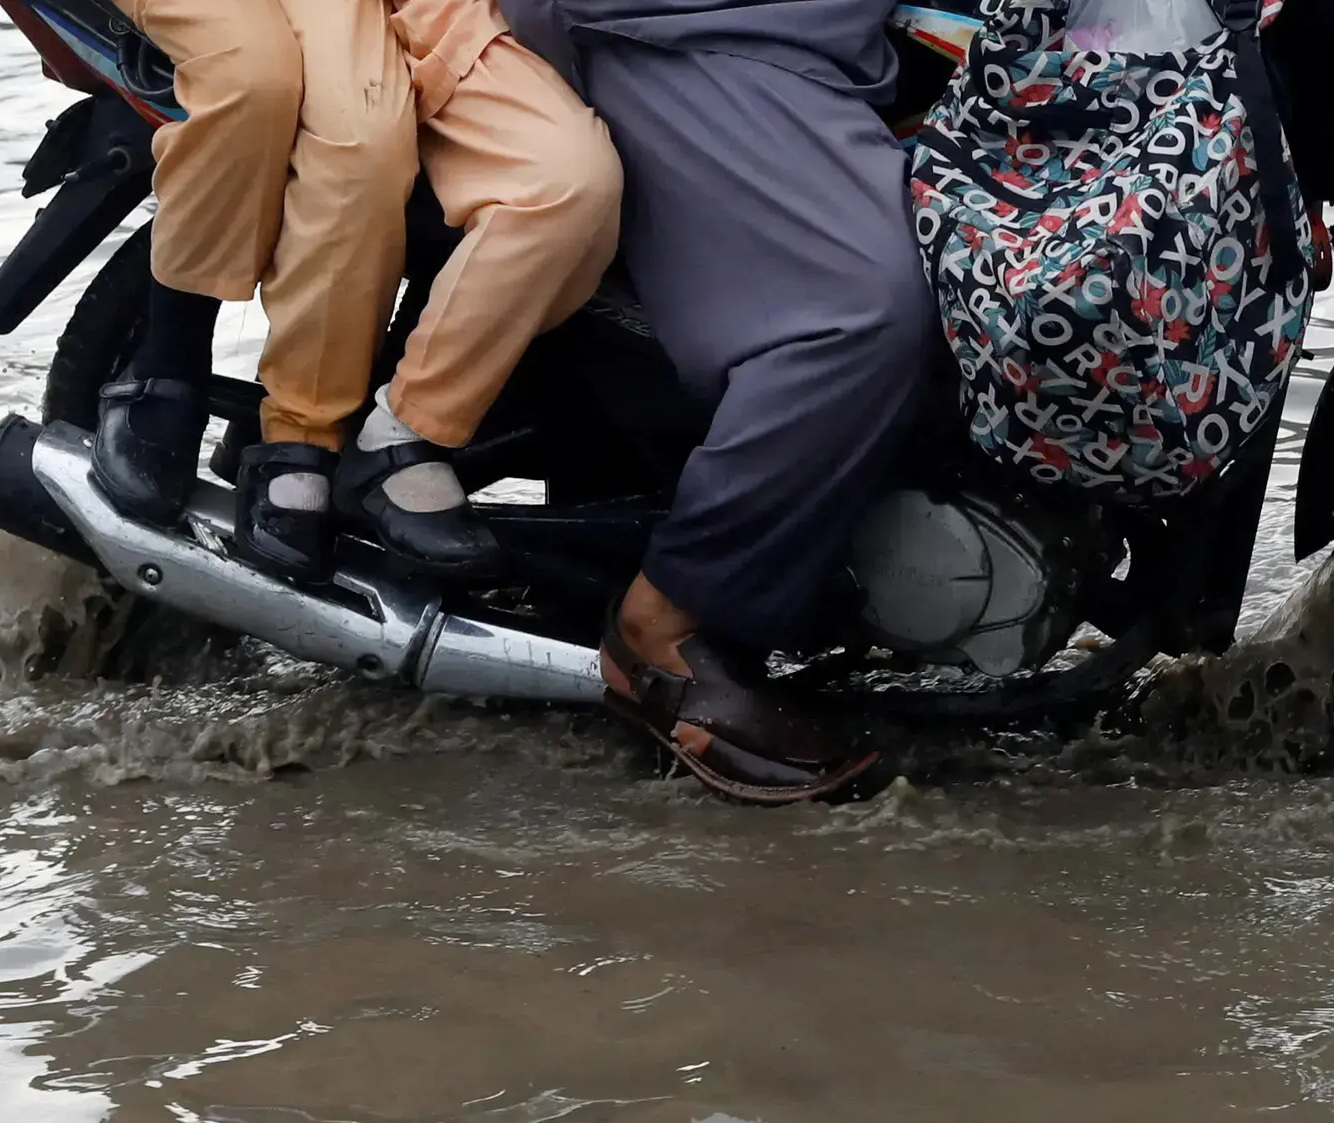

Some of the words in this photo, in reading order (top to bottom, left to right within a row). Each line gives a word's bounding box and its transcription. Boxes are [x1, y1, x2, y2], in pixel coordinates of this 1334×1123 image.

[984, 63, 1011, 98] O
[1013, 52, 1064, 92] Y
[1064, 51, 1111, 87] R
[1146, 70, 1185, 106] O
[1017, 143, 1051, 166] O
[1207, 131, 1233, 161] O
[932, 165, 973, 192] X
[963, 189, 997, 211] O
[1076, 192, 1117, 230] R
[1138, 188, 1166, 220] O
[1218, 190, 1251, 233] R
[916, 207, 941, 245] O
[1159, 231, 1202, 283] X
[1210, 236, 1245, 281] O
[969, 287, 1001, 324] R
[1038, 275, 1077, 310] X
[1082, 273, 1112, 305] O
[1160, 288, 1182, 322] O
[1234, 269, 1266, 322] Y
[997, 315, 1031, 351] X
[1031, 313, 1073, 346] O
[1254, 293, 1297, 353] X
[959, 358, 976, 380] O
[968, 335, 1002, 375] X
[1003, 356, 1027, 386] O
[1040, 357, 1088, 389] Y
[1063, 342, 1102, 376] R
[1265, 343, 1296, 389] Y
[1173, 361, 1210, 403] R
[1014, 390, 1059, 432] R
[1068, 386, 1125, 423] X
[1055, 414, 1083, 432] O
[1197, 413, 1230, 454] O
[1004, 437, 1047, 465] X
[1082, 430, 1130, 472] R
[1030, 464, 1063, 482] O
